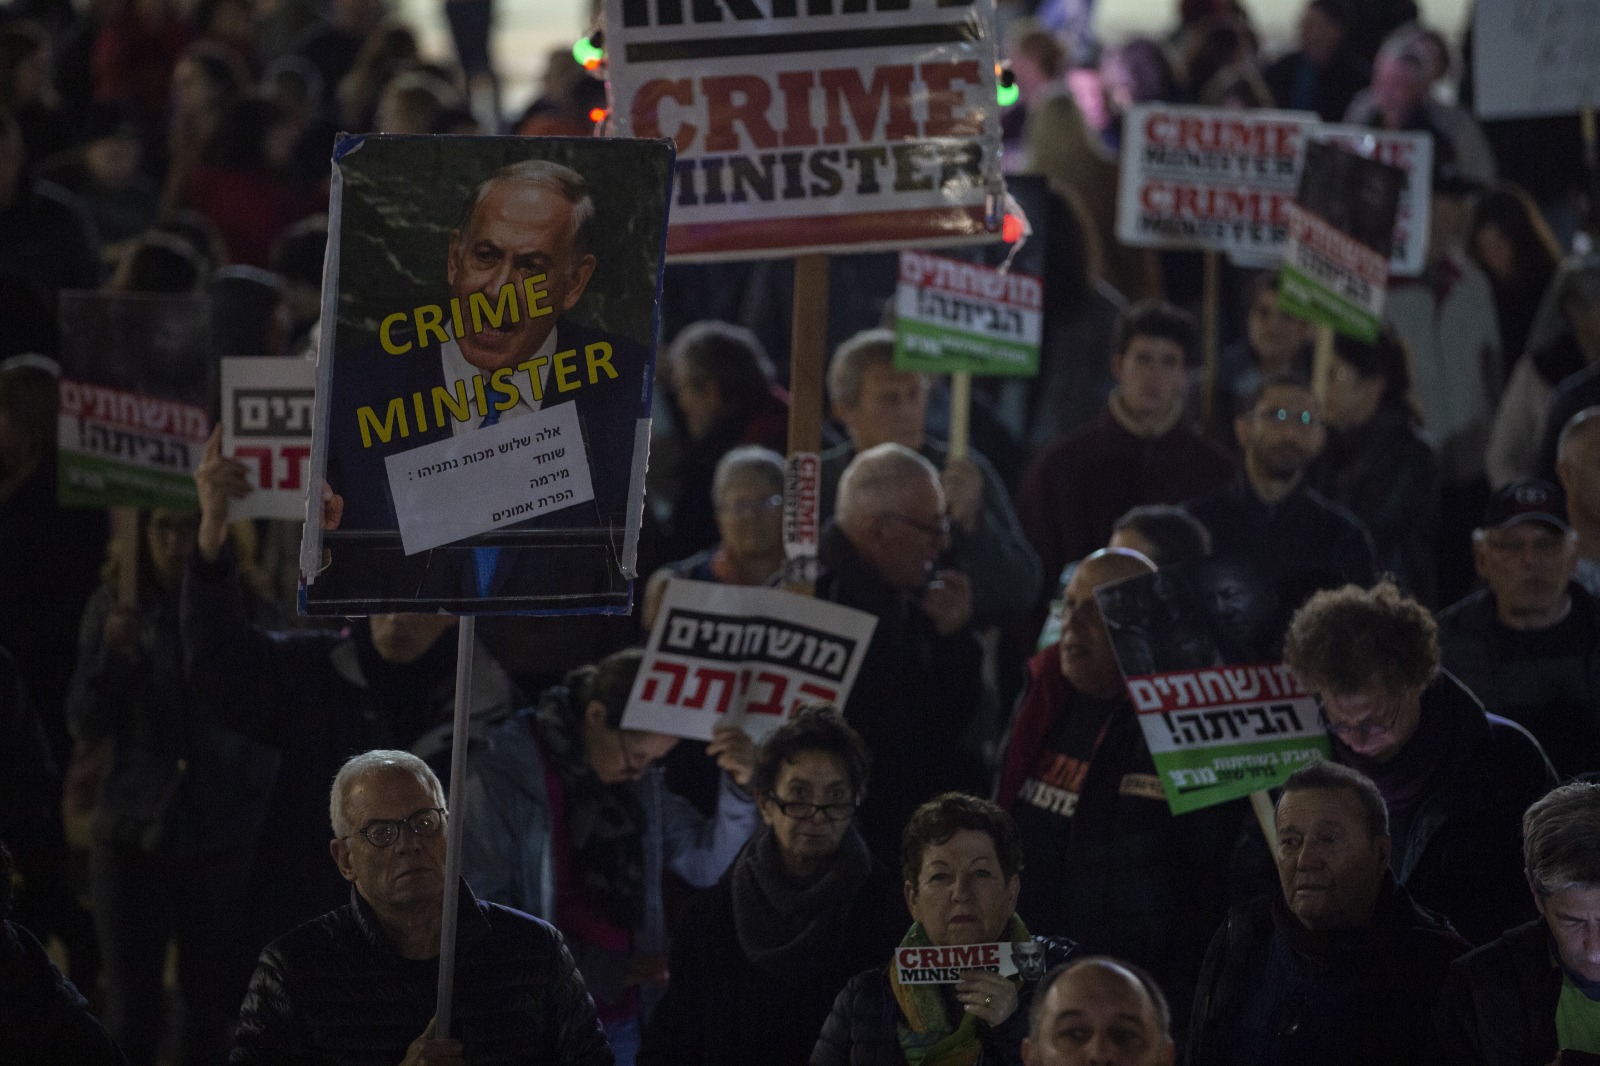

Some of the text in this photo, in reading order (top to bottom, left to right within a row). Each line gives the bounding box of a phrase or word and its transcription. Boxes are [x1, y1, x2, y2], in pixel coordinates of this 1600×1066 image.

[631, 60, 983, 154] CRIME
[1145, 114, 1298, 159] CRIME
[1141, 181, 1296, 226] CRIME
[901, 252, 1041, 306] מושחתים
[379, 272, 554, 356] CRIME
[59, 379, 208, 441] מושחתים
[356, 341, 619, 449] MINISTER
[498, 435, 531, 454] שלוש
[535, 426, 562, 443] אלה
[417, 459, 459, 478] נתניהו
[462, 448, 495, 466] מכות
[532, 447, 565, 465] שוחד
[529, 468, 570, 489] מירמה
[492, 489, 574, 522] הפרת אמונים
[800, 457, 817, 544] CRIME
[666, 615, 849, 677] מושחתים
[1162, 703, 1303, 744] הביתה!
[900, 944, 1000, 969] CRIME
[901, 965, 1000, 982] MINISR
